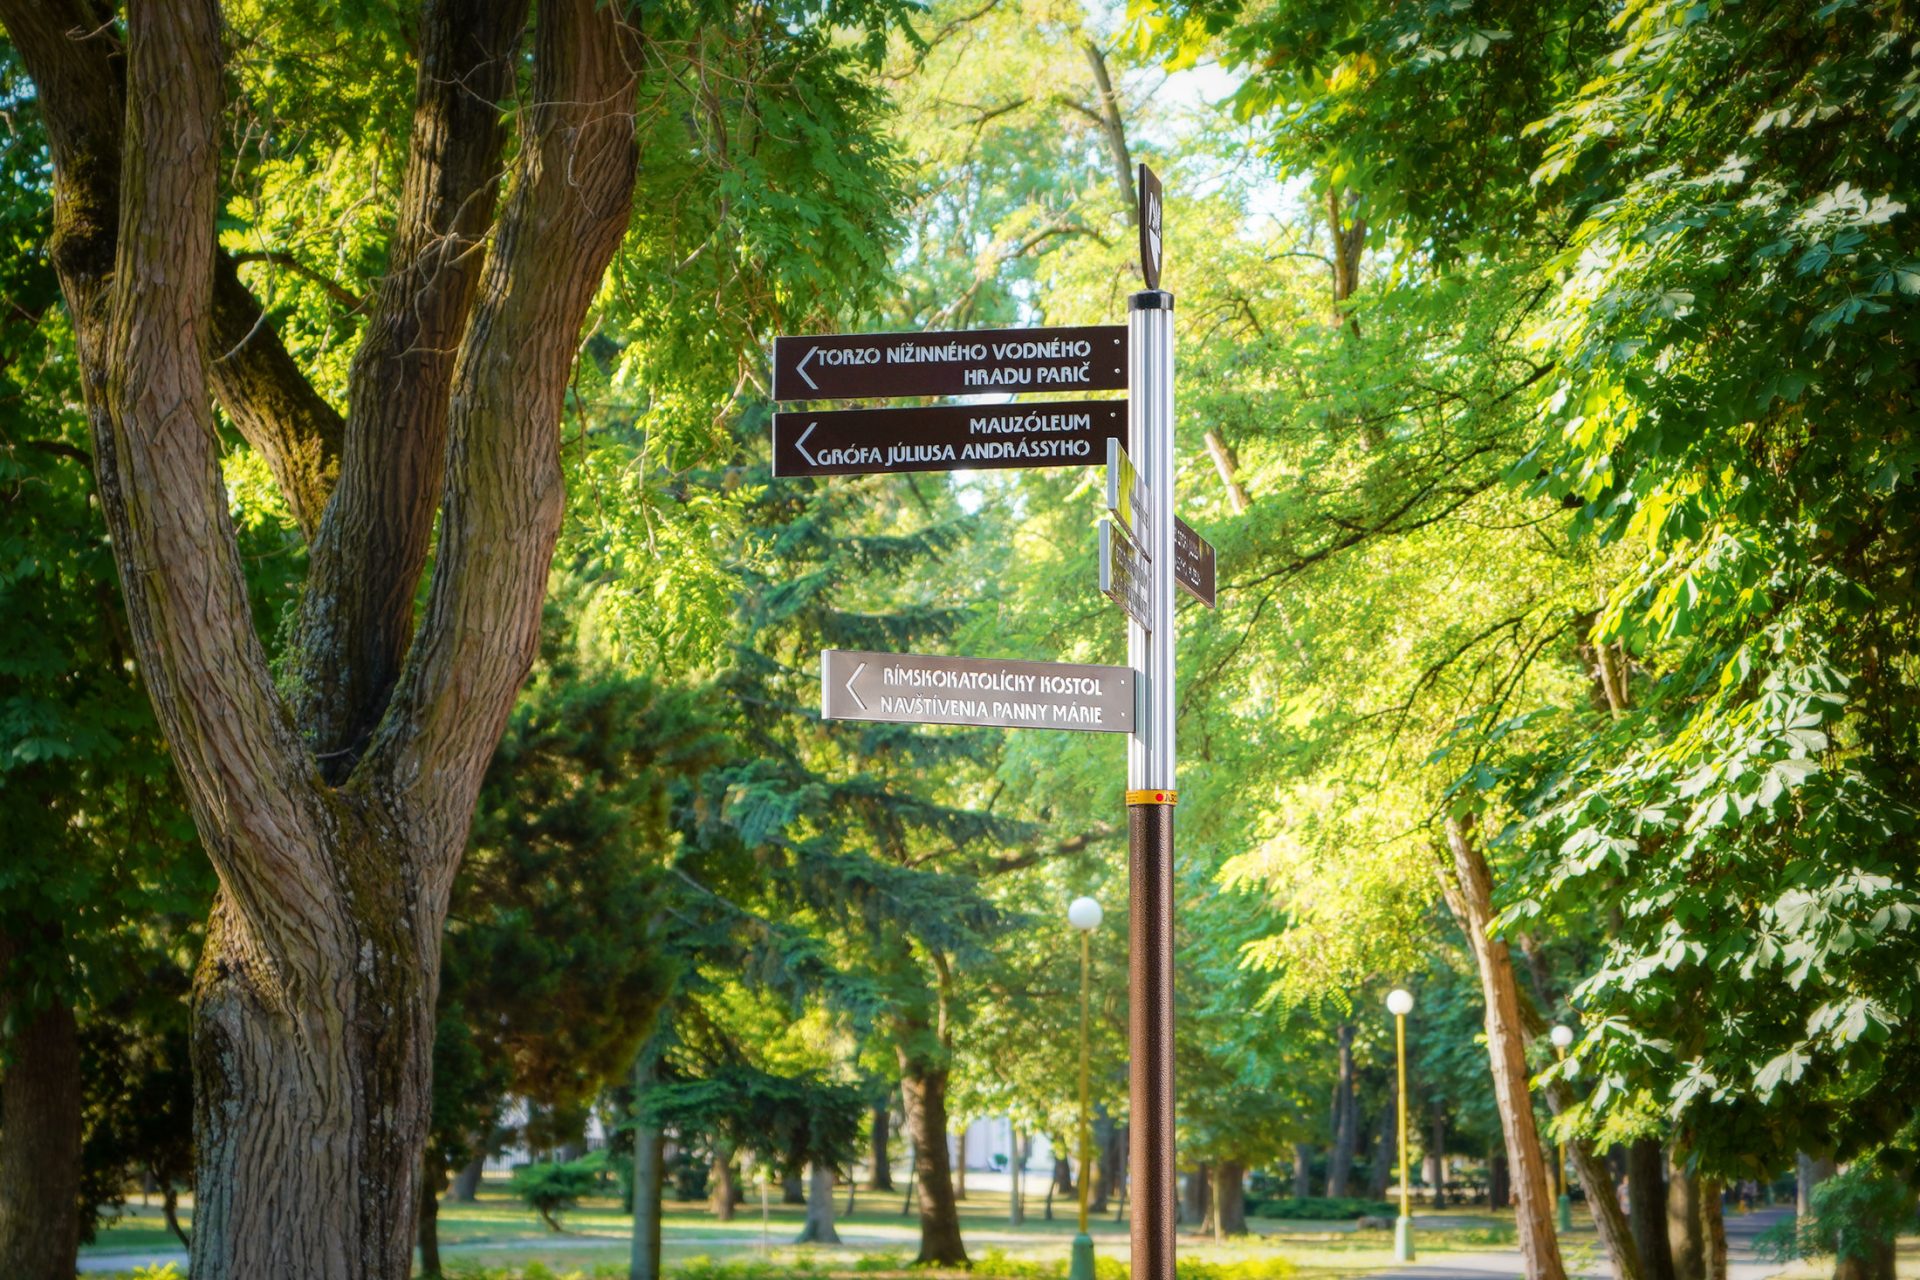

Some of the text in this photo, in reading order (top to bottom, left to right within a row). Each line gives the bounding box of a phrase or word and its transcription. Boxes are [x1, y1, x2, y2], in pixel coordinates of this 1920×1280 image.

[817, 337, 1091, 366] TORZO NÍŽINNÉHO VODNÉHO
[964, 361, 1091, 386] HRADU PARIČ
[970, 411, 1091, 435] MAUZÓLEUM
[817, 439, 1091, 467] GRÓFA JÚLIUSA ANDRÁSSYHO
[883, 664, 1103, 697] RÍMSKOKATOLÍCKY KOSTOL
[880, 694, 1103, 724] NAVŠTÍVENIA PANNY MÁRIE
